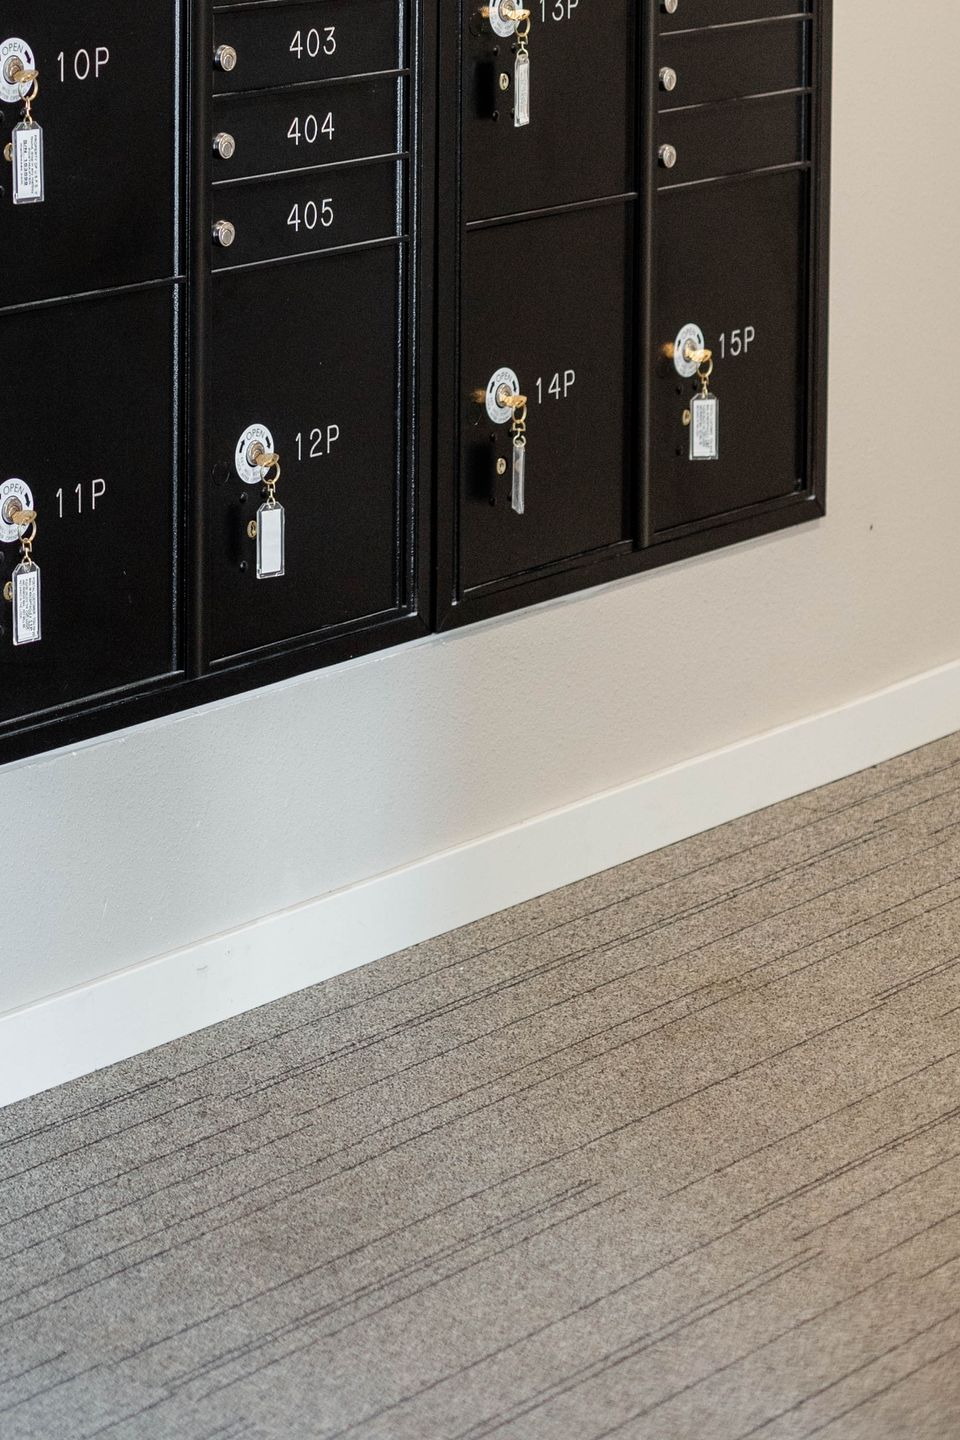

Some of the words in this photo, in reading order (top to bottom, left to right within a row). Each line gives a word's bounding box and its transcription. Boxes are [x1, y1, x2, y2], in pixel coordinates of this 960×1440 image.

[2, 42, 24, 56] OPEN
[289, 26, 337, 60] 403
[57, 46, 110, 83] 10P
[286, 111, 335, 146] 404
[286, 197, 334, 232] 405
[718, 325, 756, 359] 15P
[496, 371, 512, 382] OPEN
[535, 369, 576, 404] 14P
[246, 429, 265, 441] OPEN
[295, 424, 340, 461] 12P
[3, 483, 25, 495] OPEN
[55, 478, 106, 518] 11P
